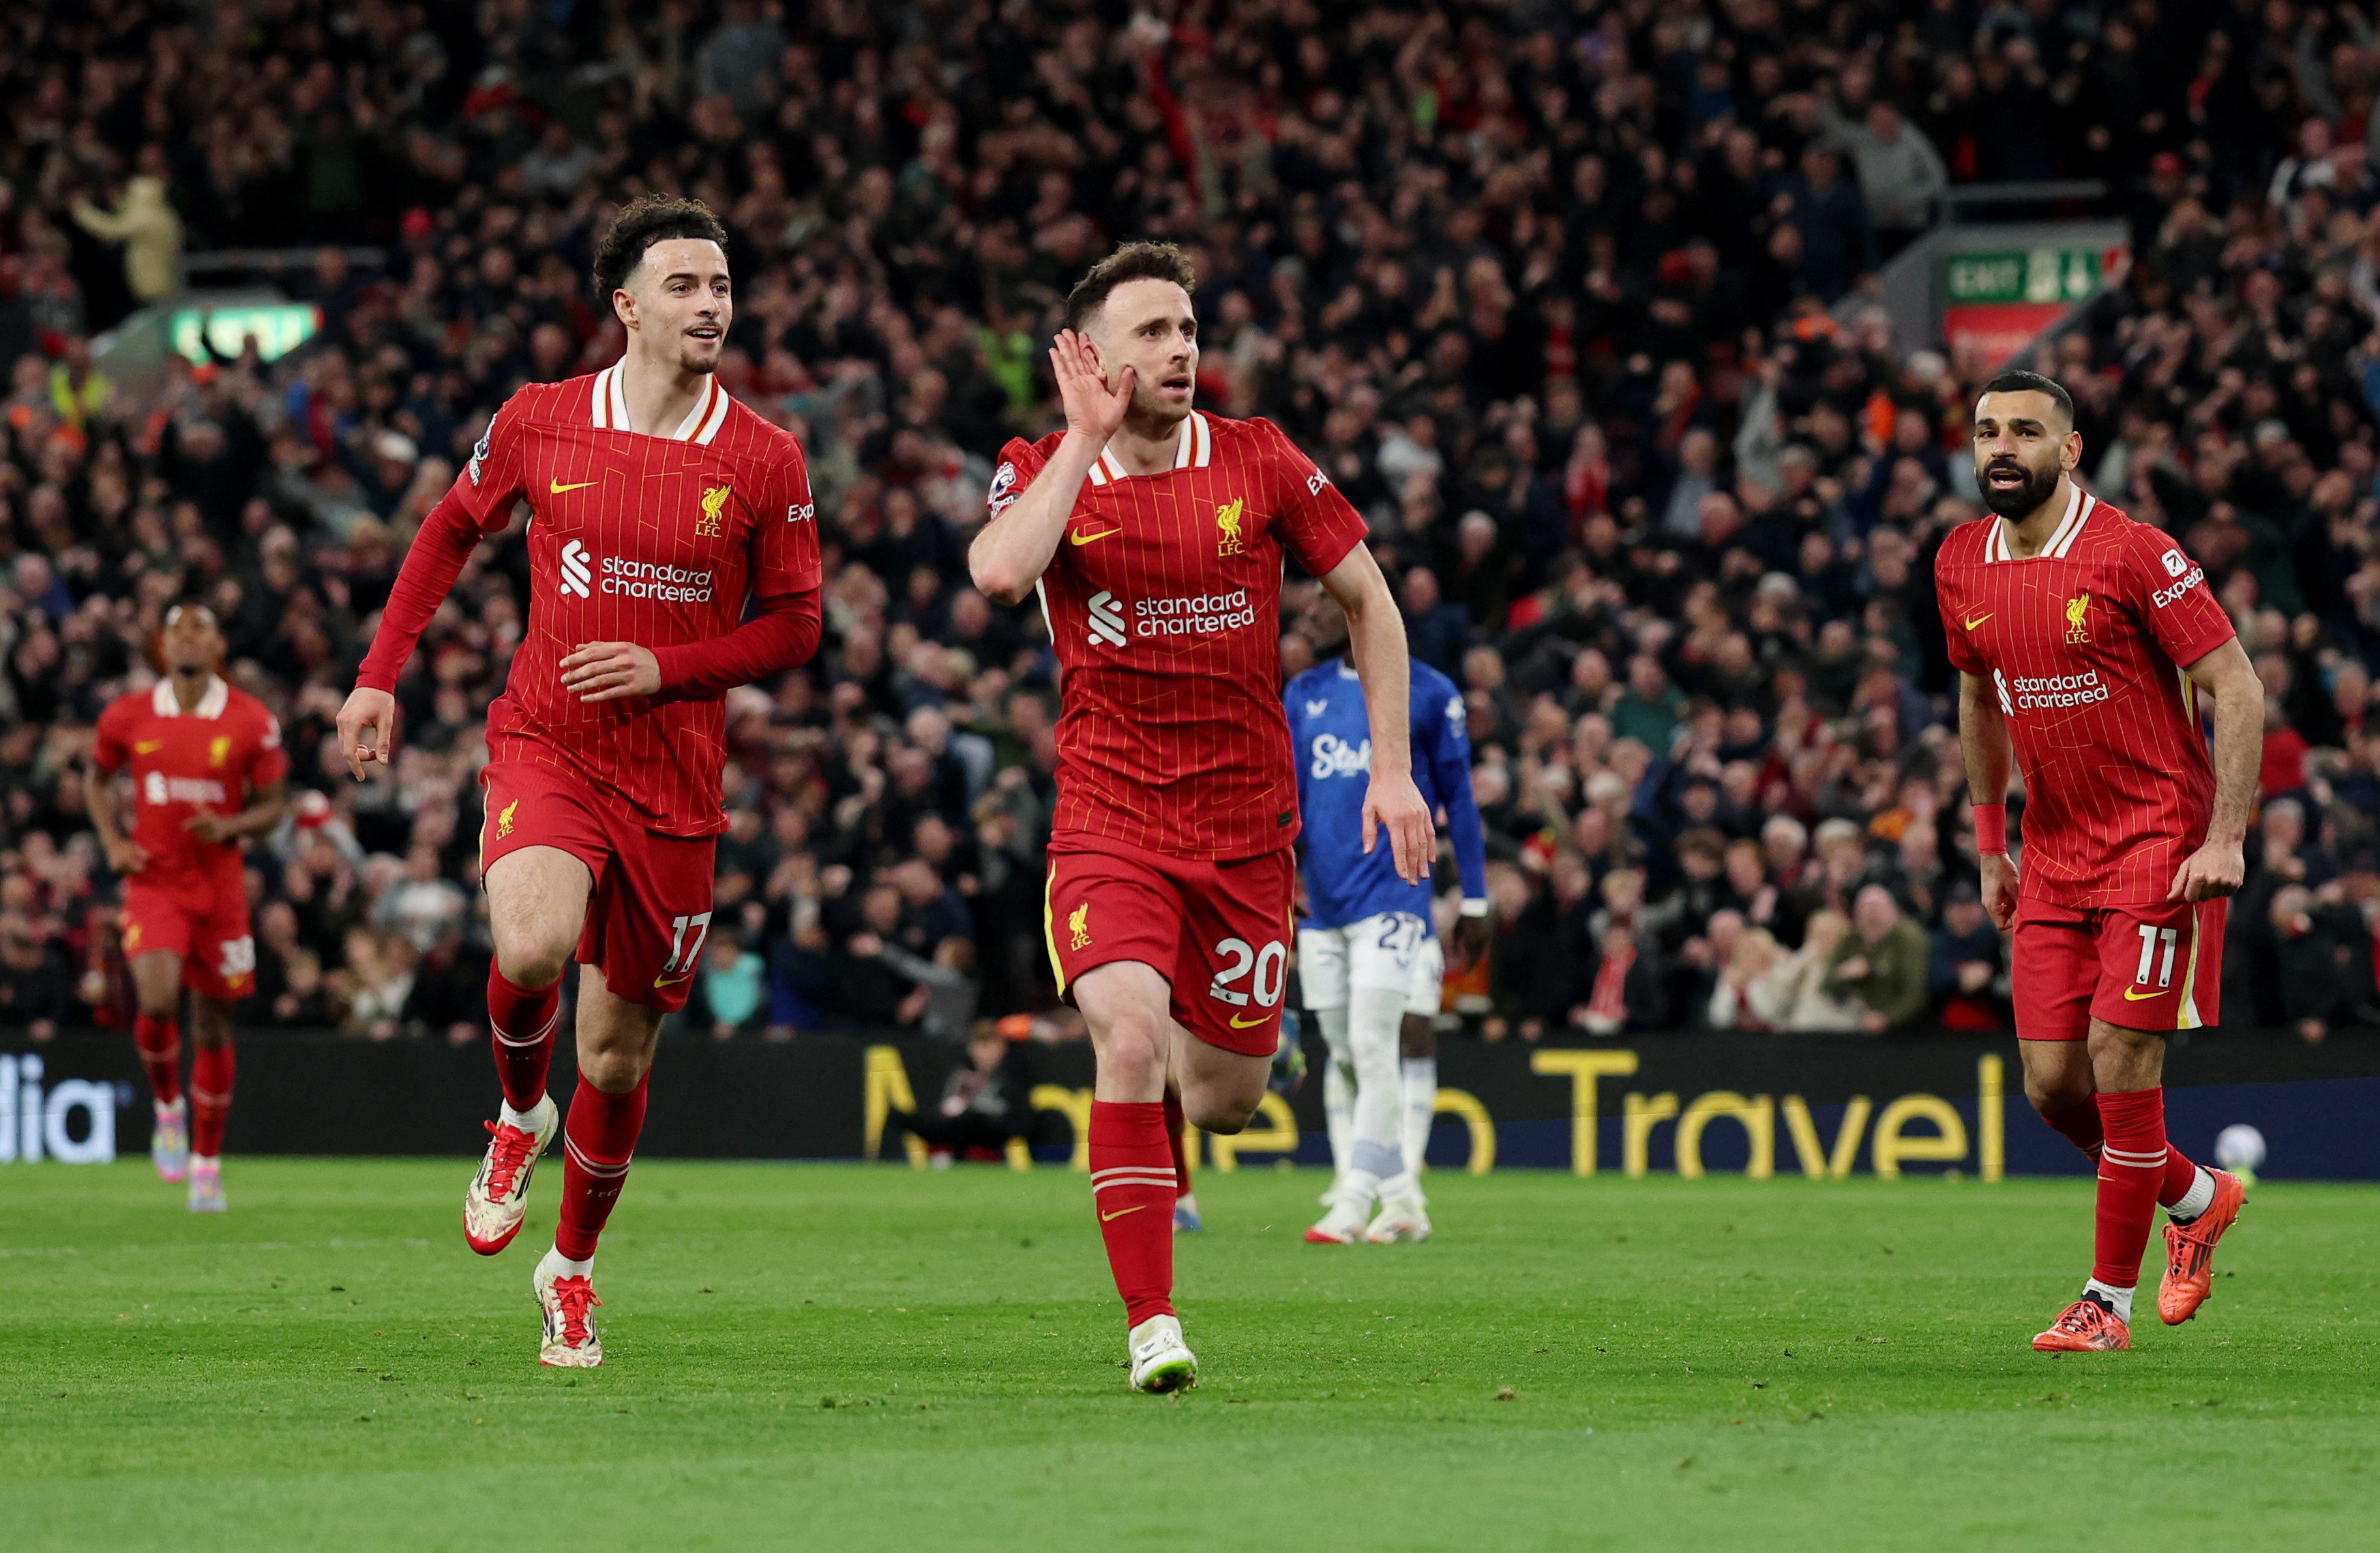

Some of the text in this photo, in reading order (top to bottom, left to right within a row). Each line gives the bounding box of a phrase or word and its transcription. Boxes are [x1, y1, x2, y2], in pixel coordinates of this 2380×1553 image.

[601, 555, 713, 586] standard
[601, 575, 713, 603] chartered
[1135, 586, 1247, 616] standard
[1137, 604, 1255, 637] chartered
[2013, 668, 2099, 693] standard
[2017, 683, 2110, 710] chartered
[661, 910, 713, 974] 17
[2135, 924, 2177, 988] 11
[1208, 937, 1287, 1008] 20
[1529, 1048, 2006, 1183] Travel
